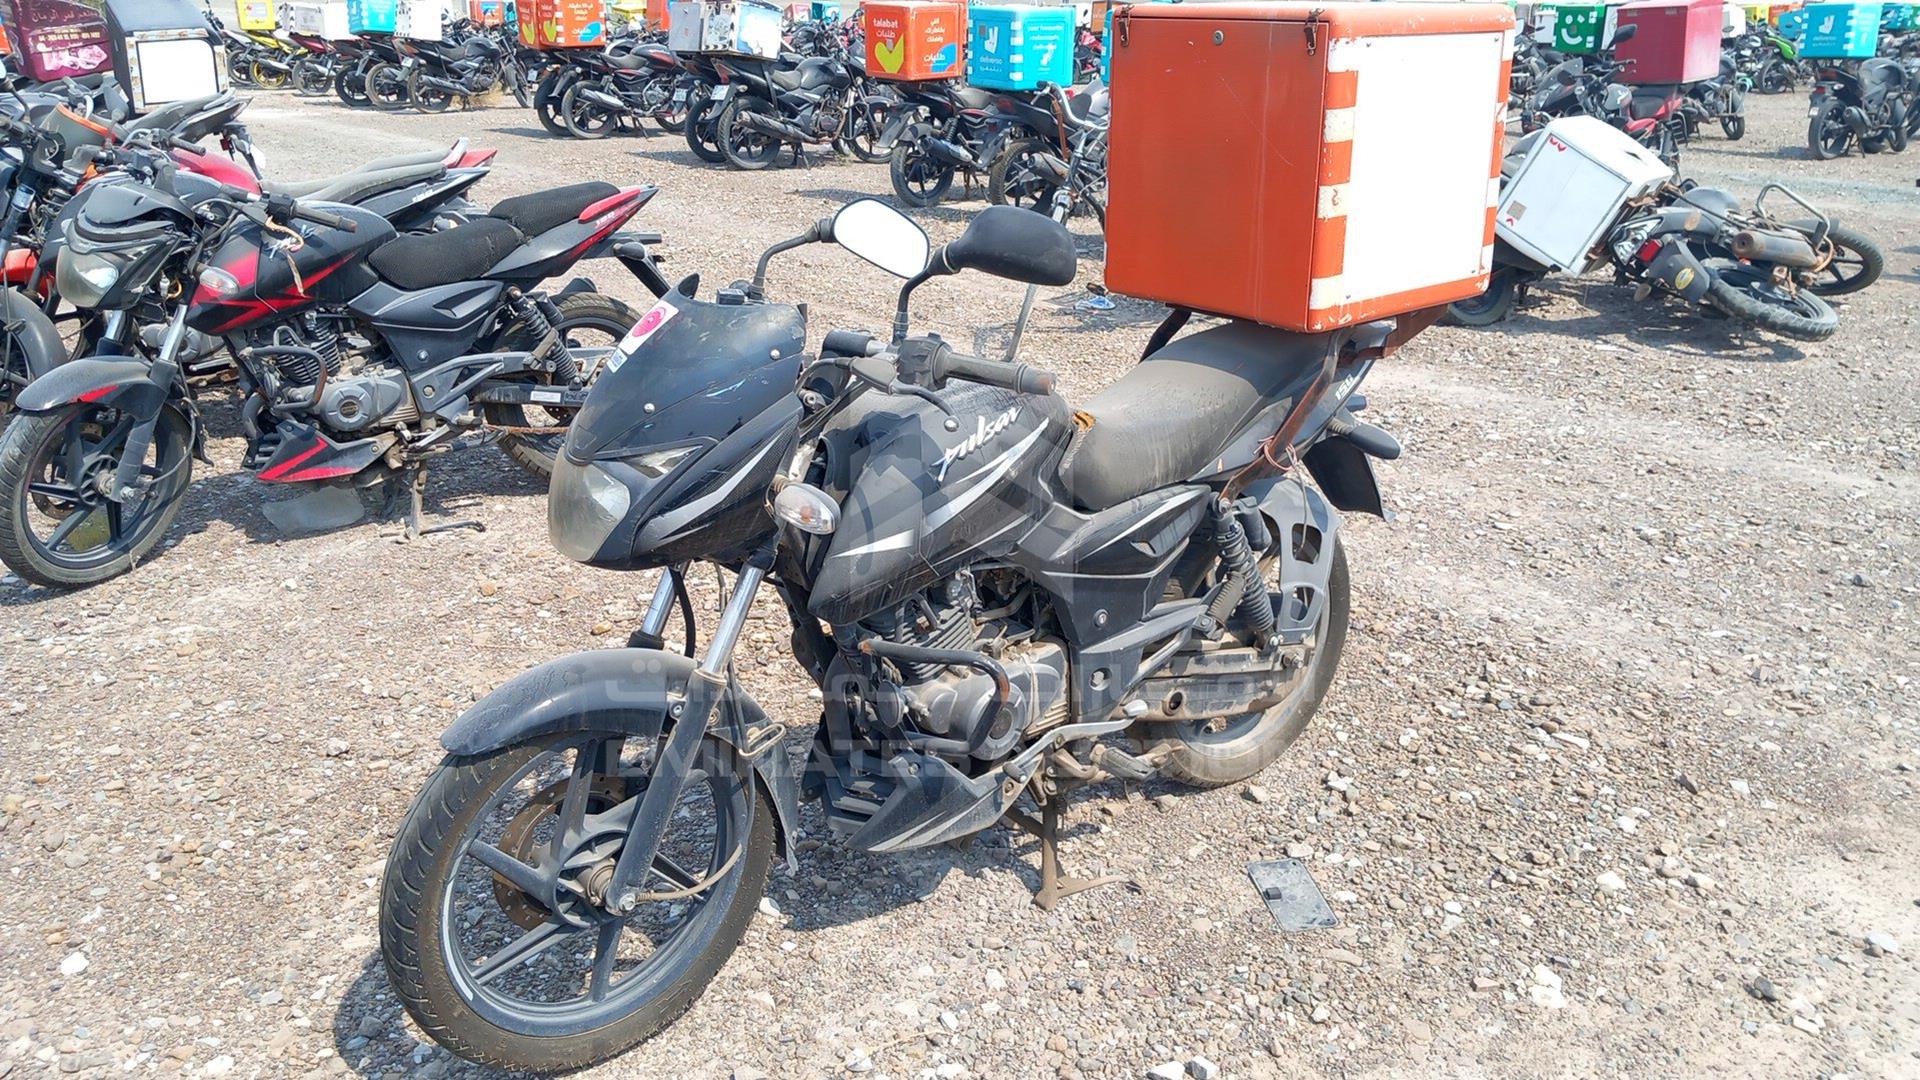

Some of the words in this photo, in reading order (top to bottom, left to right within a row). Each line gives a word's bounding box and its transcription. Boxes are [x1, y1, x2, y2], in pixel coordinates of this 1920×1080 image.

[873, 18, 898, 28] talabat
[875, 30, 896, 38] طلبات
[923, 53, 946, 63] طلبات
[1335, 374, 1355, 400] 150
